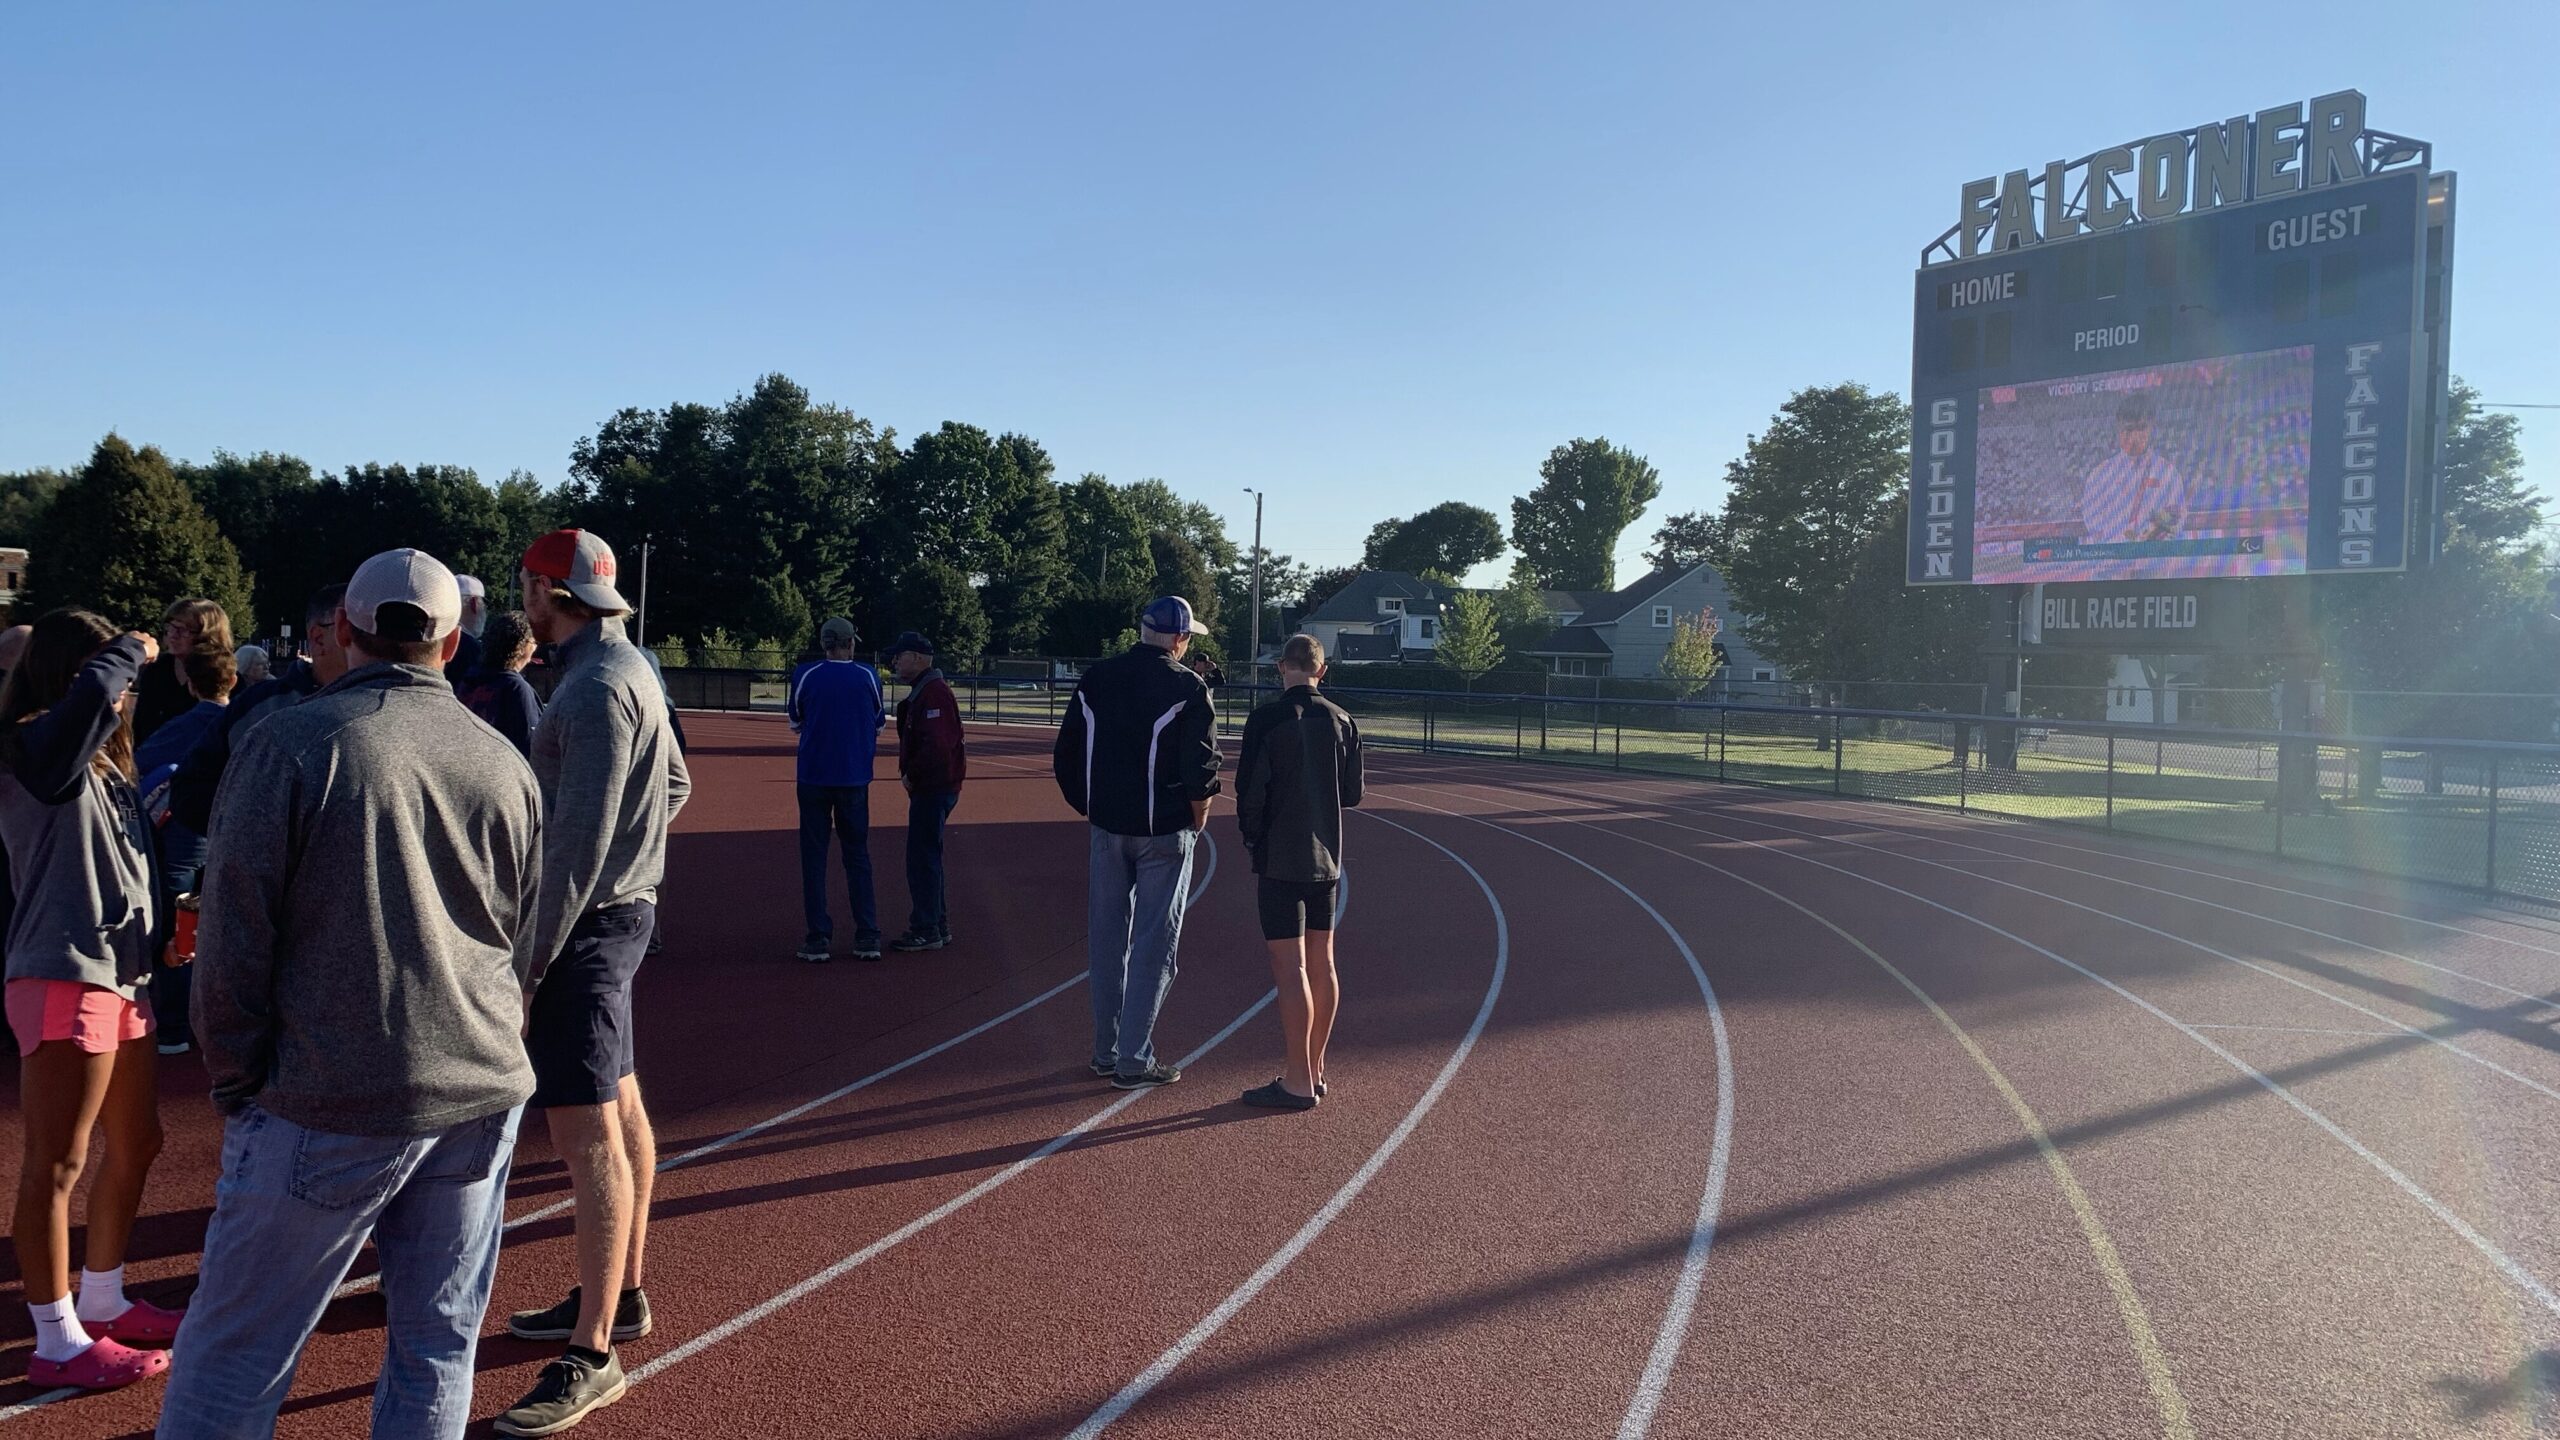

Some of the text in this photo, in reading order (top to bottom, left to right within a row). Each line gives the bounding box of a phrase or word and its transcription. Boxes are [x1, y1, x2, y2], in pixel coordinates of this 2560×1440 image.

[1961, 88, 2367, 259] FALCONER
[2267, 203, 2368, 251] GUEST
[1950, 271, 2016, 308] HOME
[2074, 323, 2140, 352] PERIOD
[2048, 381, 2089, 397] VICTORY
[2338, 341, 2382, 567] FALCONS
[1924, 397, 1958, 580] GOLDEN
[2043, 595, 2198, 630] BILL RACE FIELD
